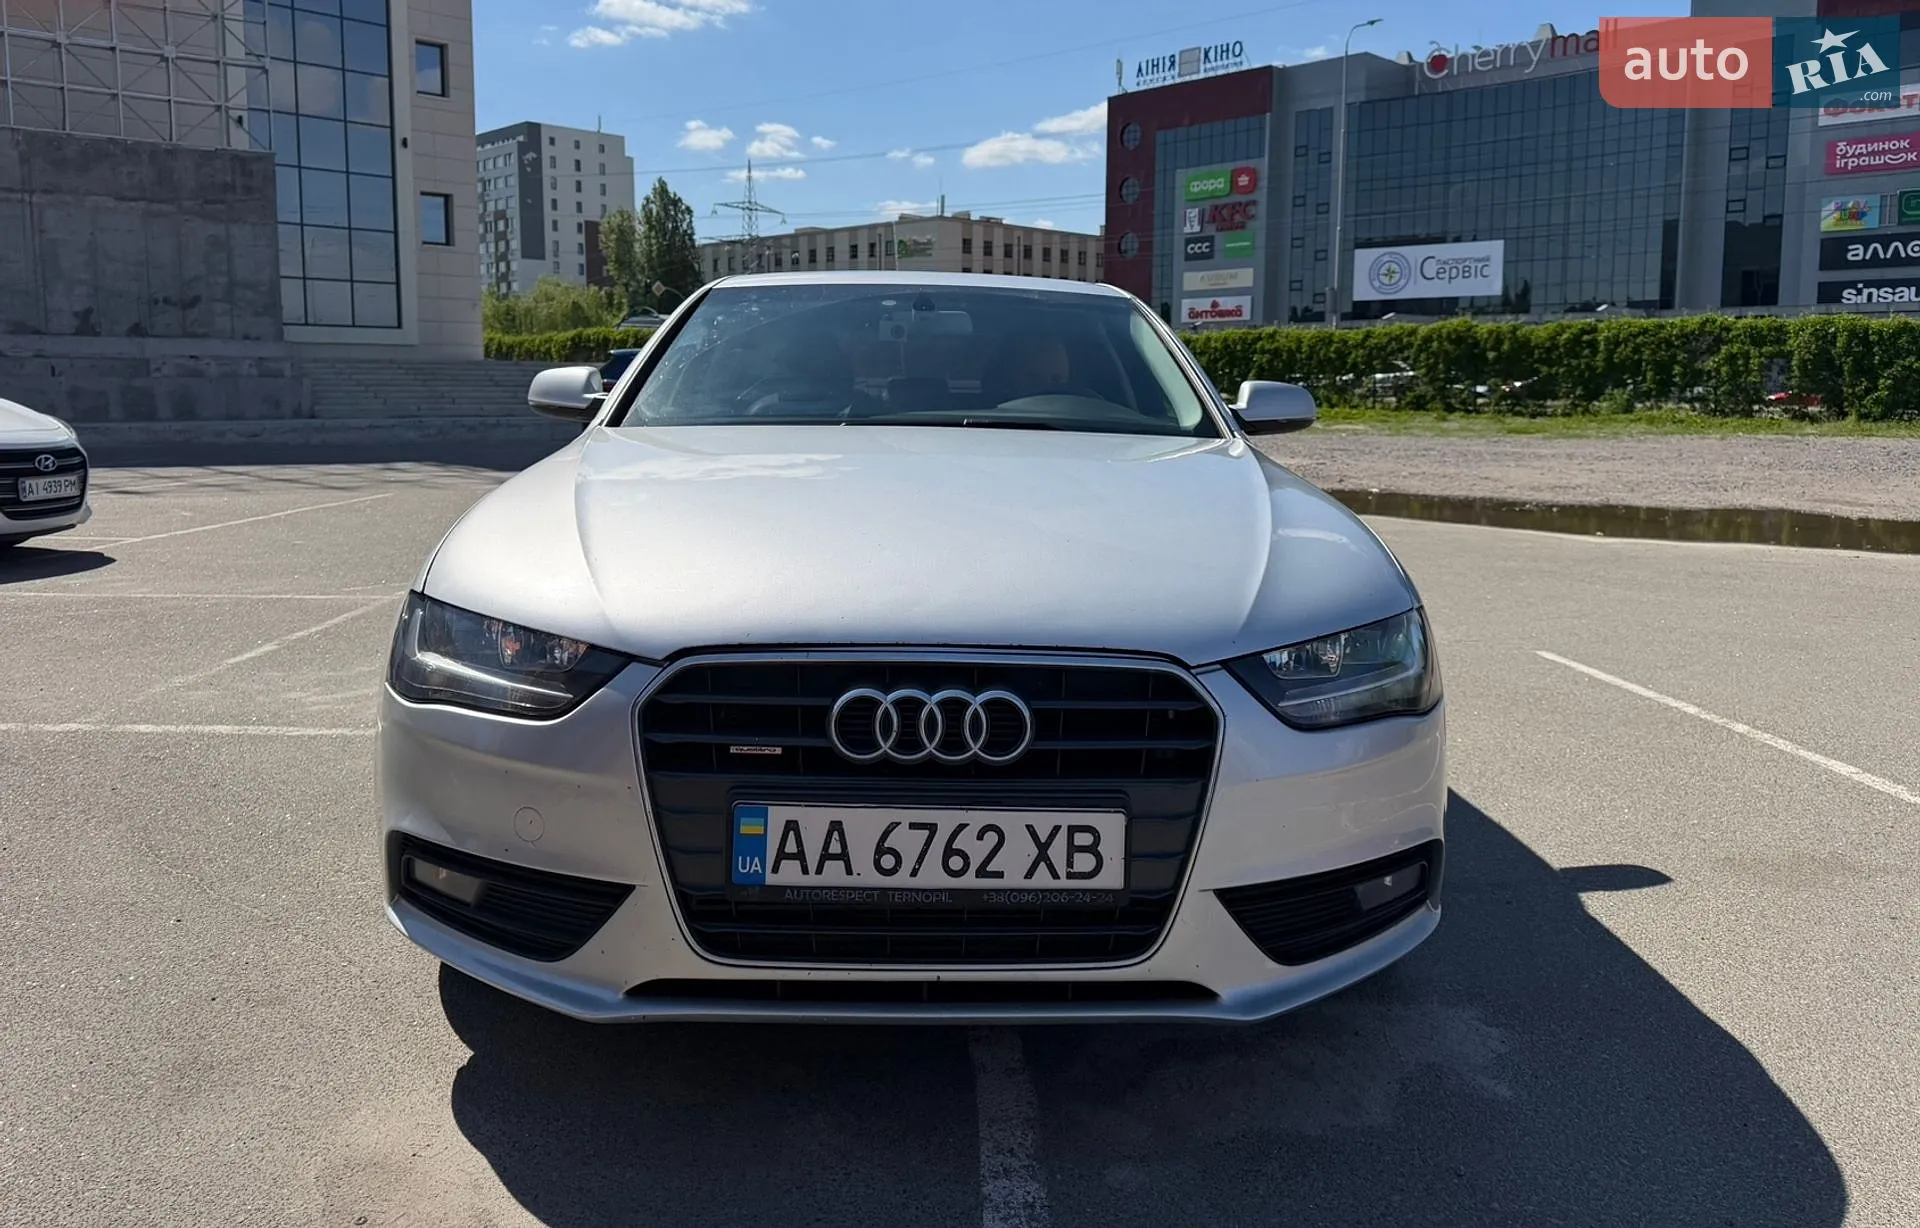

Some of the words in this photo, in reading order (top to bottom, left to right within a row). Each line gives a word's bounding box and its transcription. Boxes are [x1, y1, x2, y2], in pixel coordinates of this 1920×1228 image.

[1136, 54, 1176, 79] ЛІНІЯ
[1203, 40, 1244, 65] КІНО
[1836, 139, 1911, 157] будинок
[1205, 199, 1257, 225] KFC
[1420, 255, 1491, 285] Сервіс
[771, 819, 854, 876] AA
[873, 821, 1006, 880] 6762
[1023, 824, 1104, 881] XB
[738, 856, 763, 874] UA
[783, 889, 880, 902] AUTORESPECT
[888, 890, 953, 904] TERNOPIL
